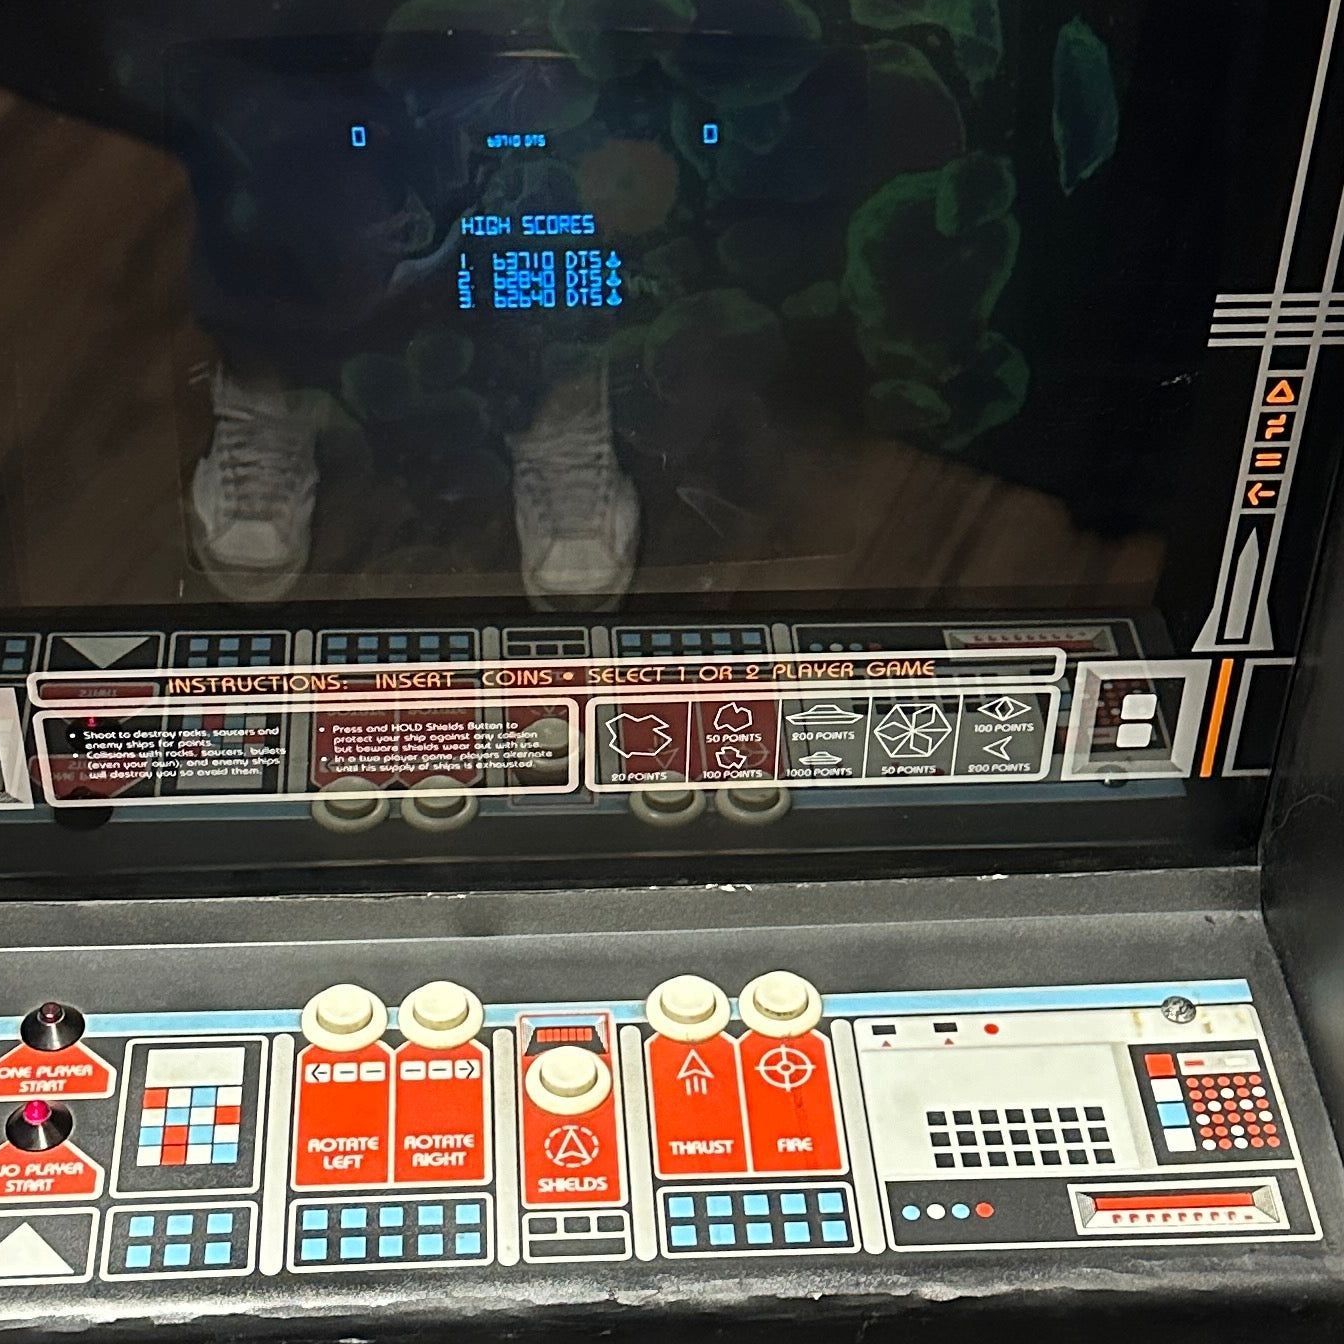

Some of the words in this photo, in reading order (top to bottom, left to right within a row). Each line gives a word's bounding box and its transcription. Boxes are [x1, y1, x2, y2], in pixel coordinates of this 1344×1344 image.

[461, 215, 511, 236] HIGH
[521, 213, 595, 235] SCORES
[492, 250, 554, 270] 63710
[565, 250, 602, 269] DTS
[493, 270, 555, 290] 62840
[566, 269, 602, 287] DTS
[494, 289, 555, 309] 62640
[566, 288, 602, 307] DTS
[168, 674, 348, 694] INSTRUCTIONS:
[375, 671, 455, 690] INSERT
[481, 670, 553, 687] COINS
[587, 667, 666, 683] SELECT
[676, 667, 685, 682] 1
[699, 665, 733, 681] OR
[745, 664, 758, 680] 2
[772, 662, 854, 680] PLAYER
[866, 660, 936, 677] GAME
[83, 731, 116, 739] Shoot
[118, 731, 131, 739] to
[133, 730, 176, 740] destroy
[178, 729, 210, 737] rocks,
[257, 726, 279, 735] and
[332, 725, 363, 733] Press
[366, 724, 388, 733] and
[391, 723, 423, 732] HOLD
[426, 722, 464, 731] Shields
[974, 723, 992, 733] 100
[993, 722, 1034, 732] POINTS
[334, 735, 373, 745] protect
[376, 735, 400, 744] your
[403, 734, 426, 743] ship
[429, 733, 470, 743] against
[474, 733, 494, 741] any
[497, 731, 537, 739] collision
[705, 734, 721, 743] 50
[722, 733, 762, 743] POINTS
[792, 732, 814, 741] 200
[816, 731, 855, 741] POINTS
[85, 742, 123, 750] enemy
[126, 740, 155, 750] ships
[158, 739, 174, 747] for
[334, 745, 352, 753] but
[356, 744, 399, 753] beware
[402, 743, 439, 752] shields
[474, 742, 492, 750] out
[495, 741, 518, 749] with
[86, 750, 136, 759] Collisions
[139, 750, 162, 758] with
[165, 749, 198, 758] rocks,
[250, 747, 286, 755] bullets
[334, 754, 344, 763] In
[359, 754, 381, 762] two
[383, 754, 418, 763] player
[460, 751, 500, 760] players
[503, 750, 553, 758] alternate
[87, 761, 120, 770] (even
[123, 761, 148, 770] your
[187, 758, 208, 767] and
[212, 758, 249, 767] enemy
[252, 757, 280, 767] ships
[361, 764, 376, 772] his
[379, 763, 415, 773] supply
[418, 762, 429, 771] of
[433, 762, 461, 771] ships
[881, 766, 896, 775] 50
[897, 765, 937, 775] POINTS
[968, 763, 989, 773] 200
[991, 762, 1031, 772] POINTS
[89, 771, 107, 779] will
[109, 770, 152, 779] destroy
[156, 770, 176, 778] you
[180, 769, 194, 777] so
[197, 768, 228, 776] avoid
[611, 772, 626, 782] 20
[628, 771, 668, 781] POINTS
[703, 769, 721, 779] 100
[723, 768, 763, 778] POINTS
[786, 768, 812, 778] 1000
[813, 767, 853, 777] POINTS
[36, 1064, 93, 1078] PLAYER
[18, 1079, 67, 1093] START
[307, 1136, 380, 1153] ROTATE
[404, 1134, 475, 1150] ROTATE
[668, 1139, 734, 1155] THRUST
[776, 1137, 814, 1152] FIRE
[323, 1154, 364, 1170] LEFT
[412, 1152, 468, 1168] RIGHT
[24, 1162, 85, 1176] PLAYER
[5, 1178, 55, 1193] START
[537, 1176, 608, 1193] SHIELDS
